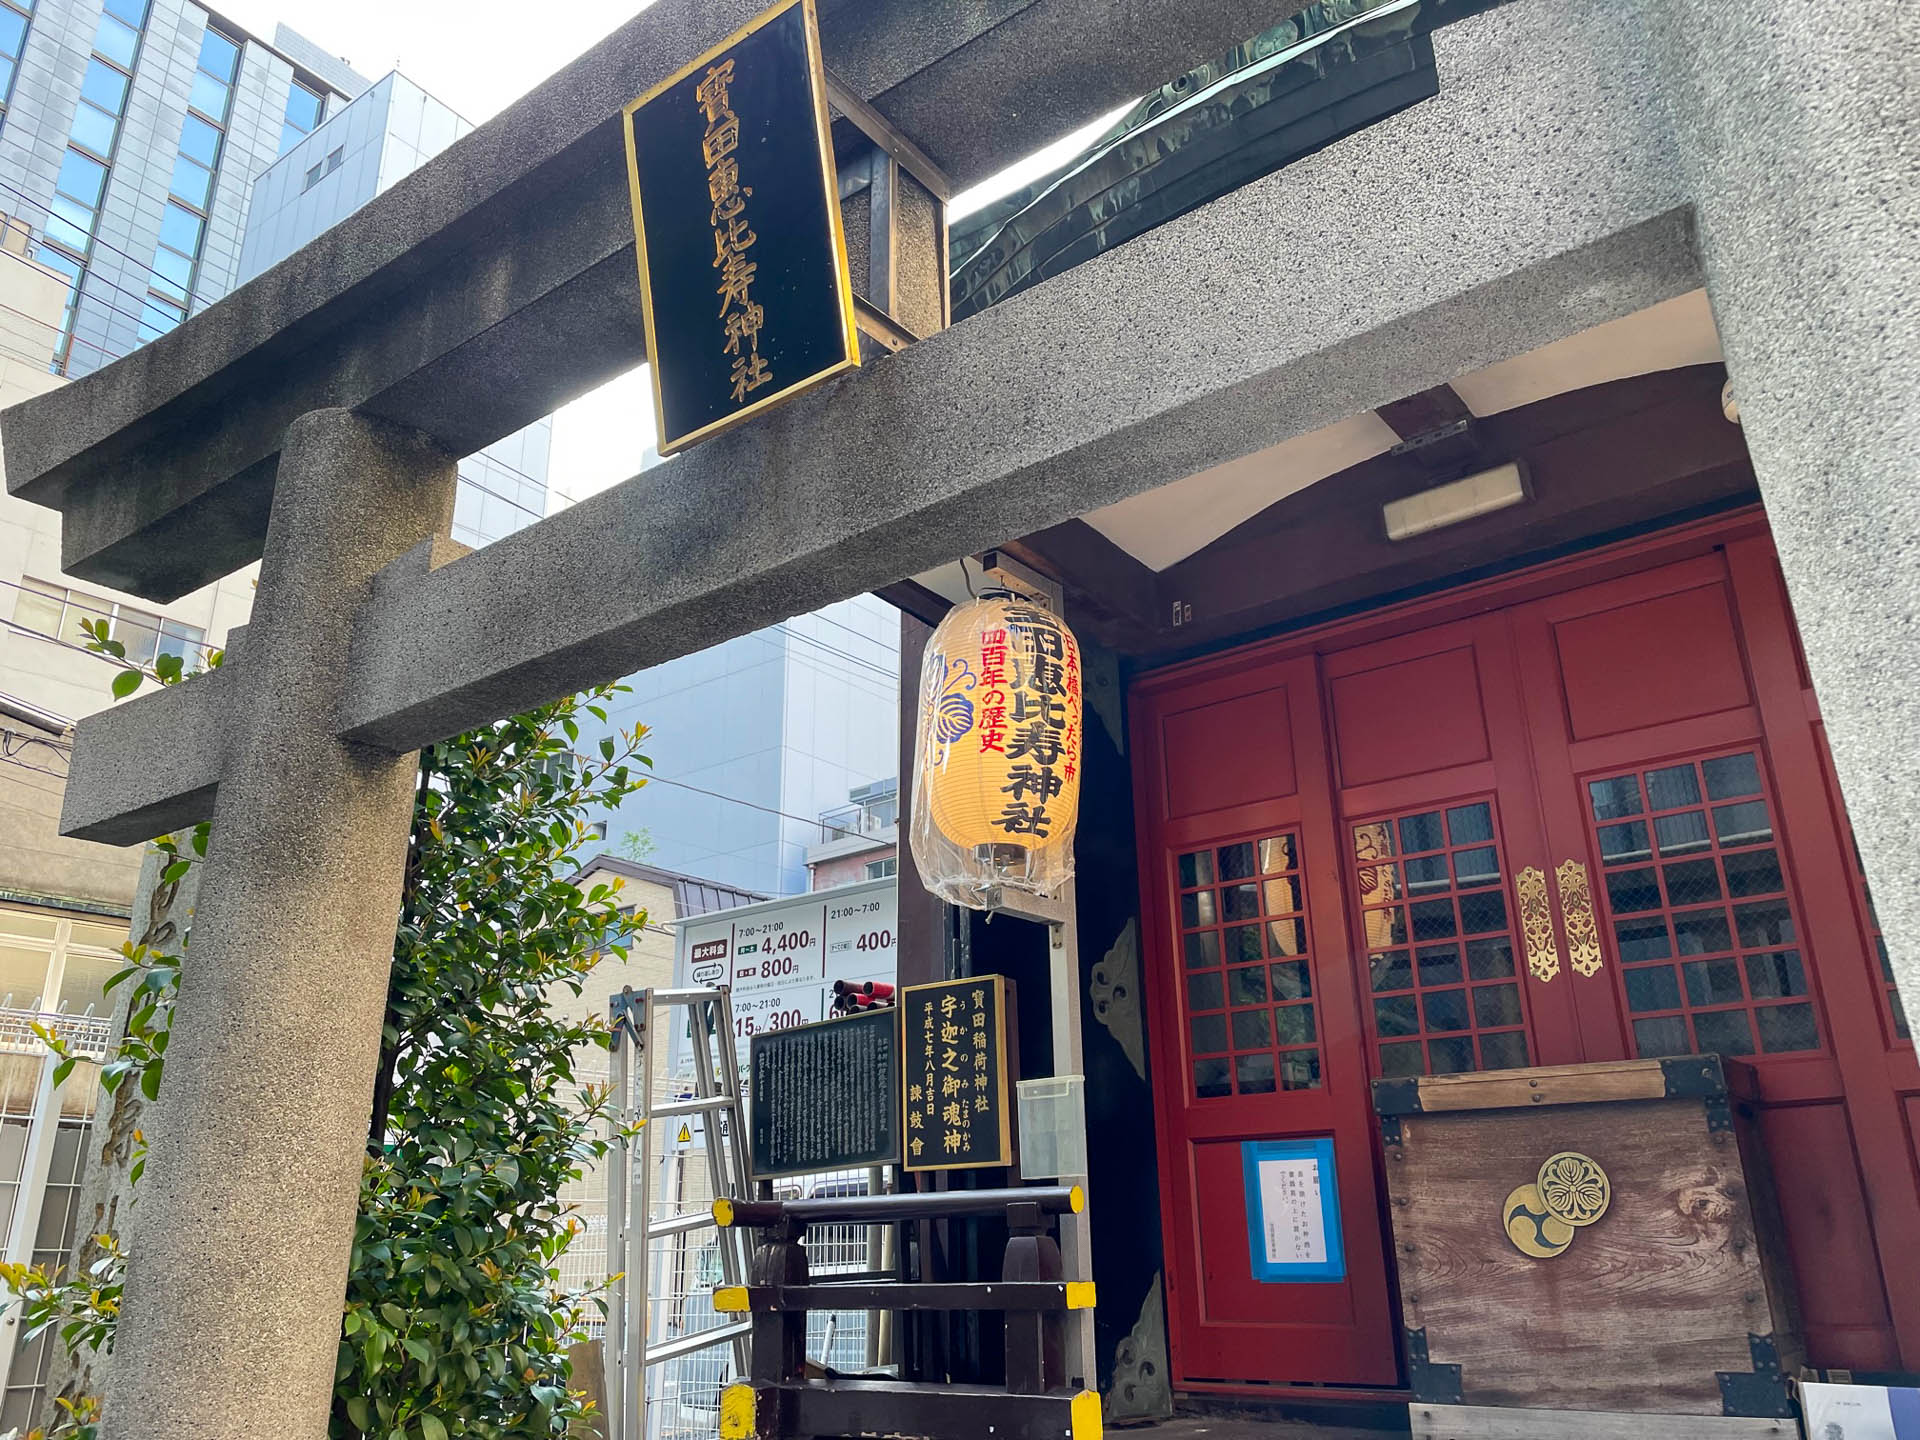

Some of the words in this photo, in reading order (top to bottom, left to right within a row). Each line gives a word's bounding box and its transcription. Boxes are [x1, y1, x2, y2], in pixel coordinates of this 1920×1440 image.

[978, 630, 1009, 753] 四百年の歴史
[761, 957, 799, 978] 800円
[762, 930, 816, 955] 4,400円
[924, 1001, 936, 1116] 平成七年八月吉日
[940, 994, 961, 1155] 宇迦之御魂神
